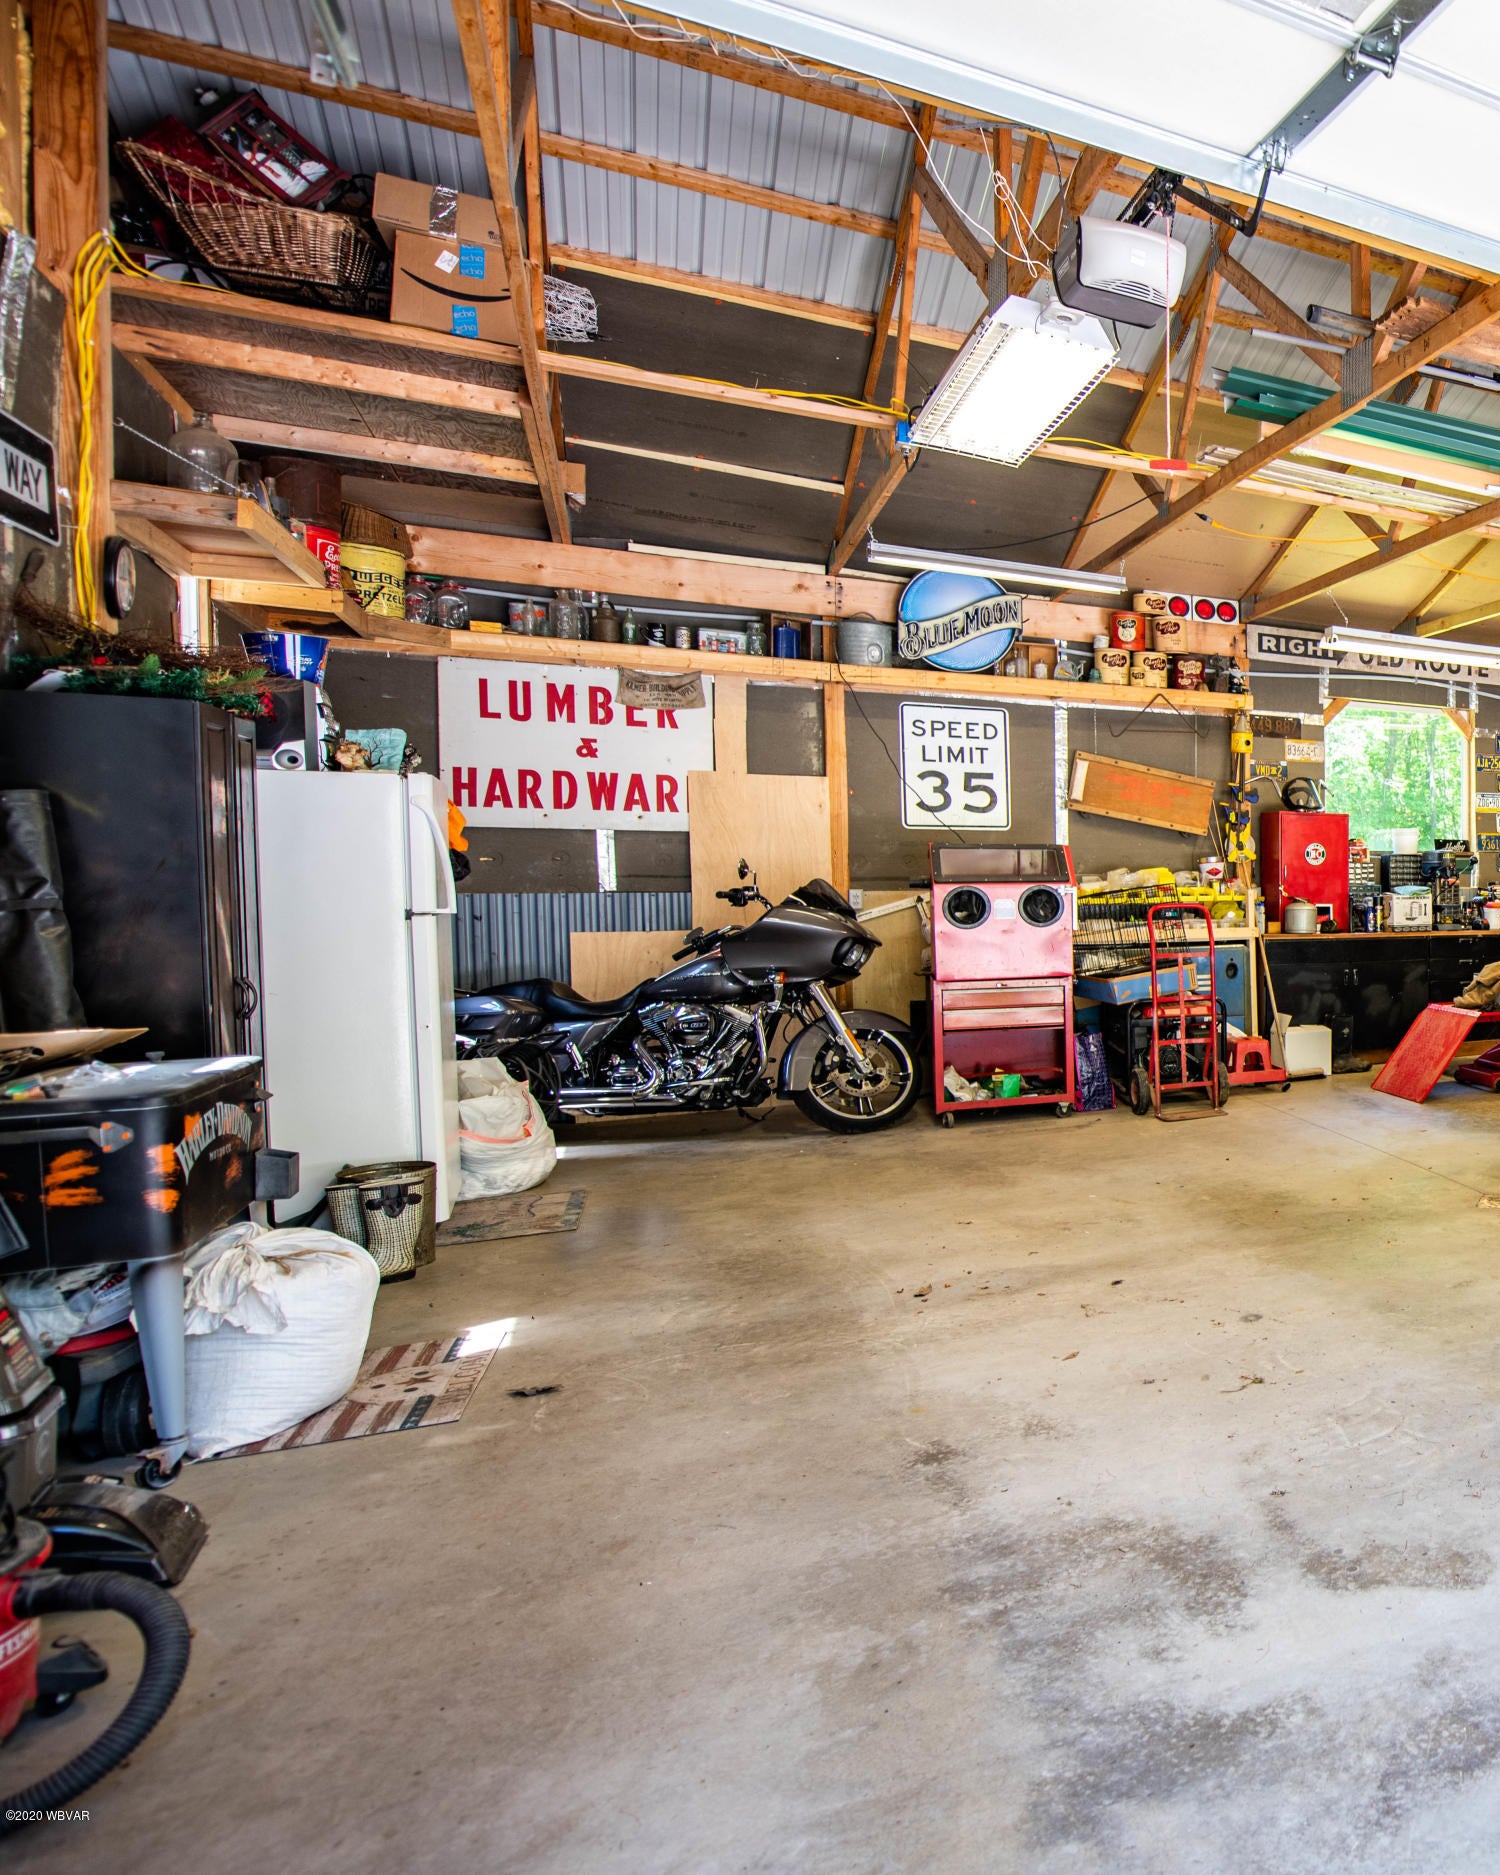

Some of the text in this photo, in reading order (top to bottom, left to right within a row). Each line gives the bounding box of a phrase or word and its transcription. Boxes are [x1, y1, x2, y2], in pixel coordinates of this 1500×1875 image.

[4, 447, 42, 503] WAY
[899, 600, 1020, 660] BLUE MOON
[575, 736, 599, 759] &
[911, 719, 999, 740] SPEED
[922, 745, 989, 764] LIMIT
[452, 766, 689, 814] HARDWAR
[916, 770, 998, 814] 35
[174, 1101, 253, 1185] HARLEY-DAVIDSON
